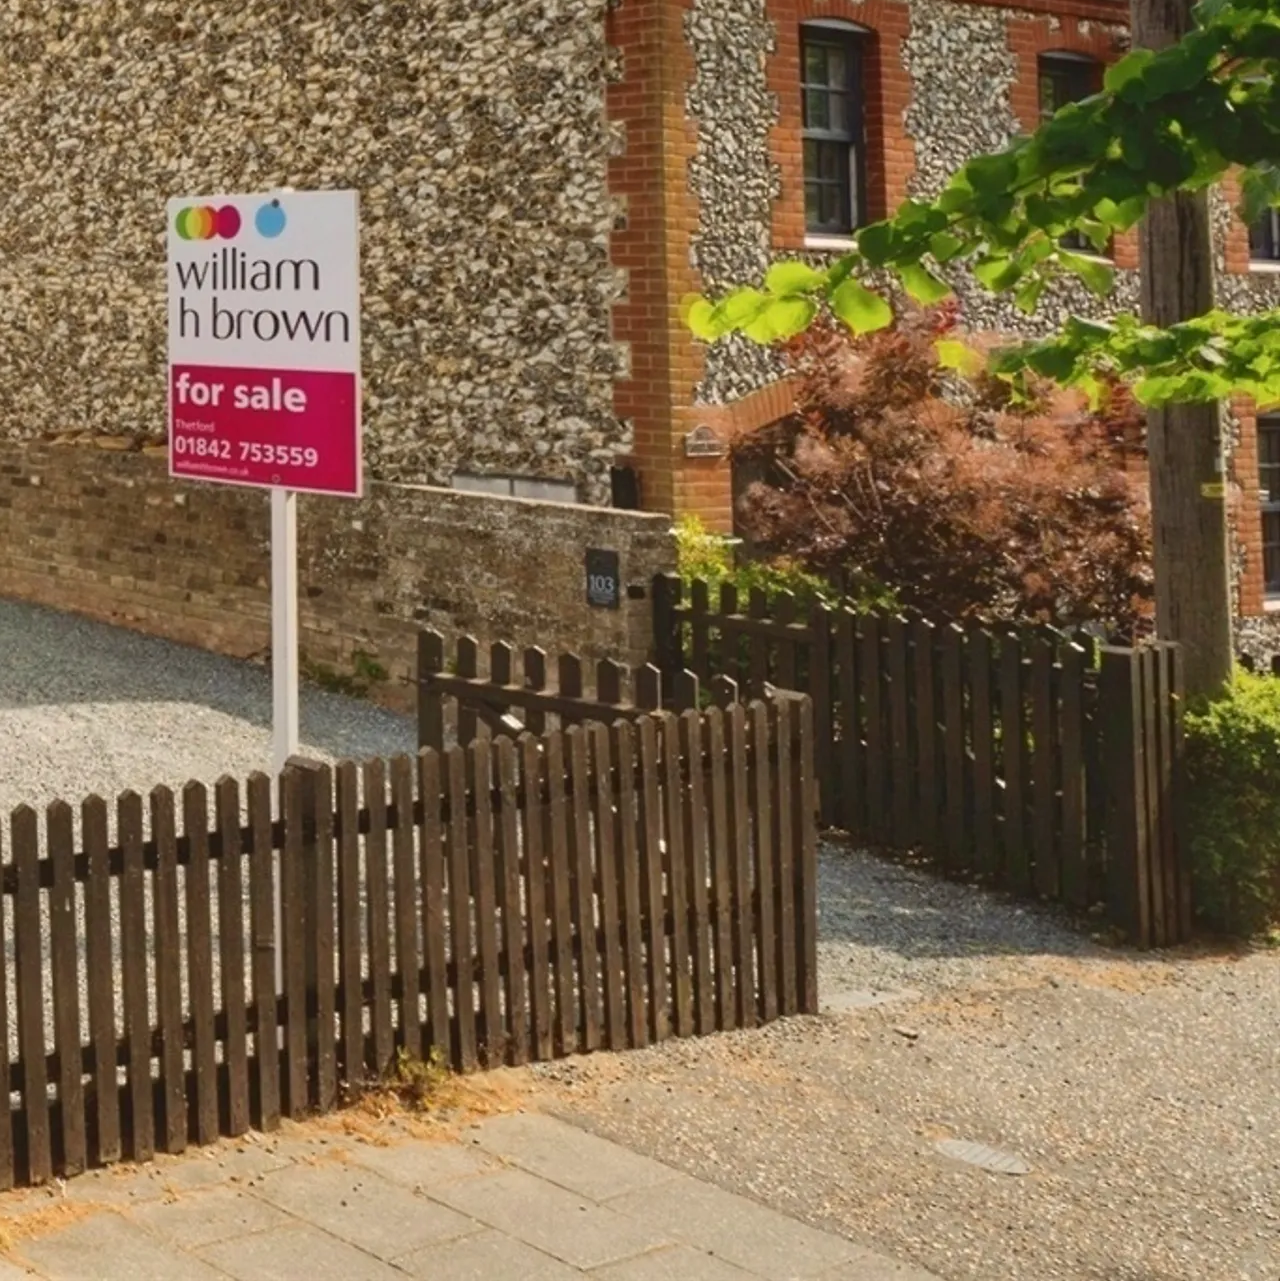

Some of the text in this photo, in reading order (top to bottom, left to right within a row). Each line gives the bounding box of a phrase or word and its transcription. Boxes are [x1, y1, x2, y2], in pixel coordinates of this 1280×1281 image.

[176, 247, 319, 291] william
[180, 297, 349, 342] h brown
[176, 372, 307, 412] for sale
[176, 419, 215, 432] Thetford
[175, 435, 318, 467] 01842 753559
[590, 574, 614, 593] 103
